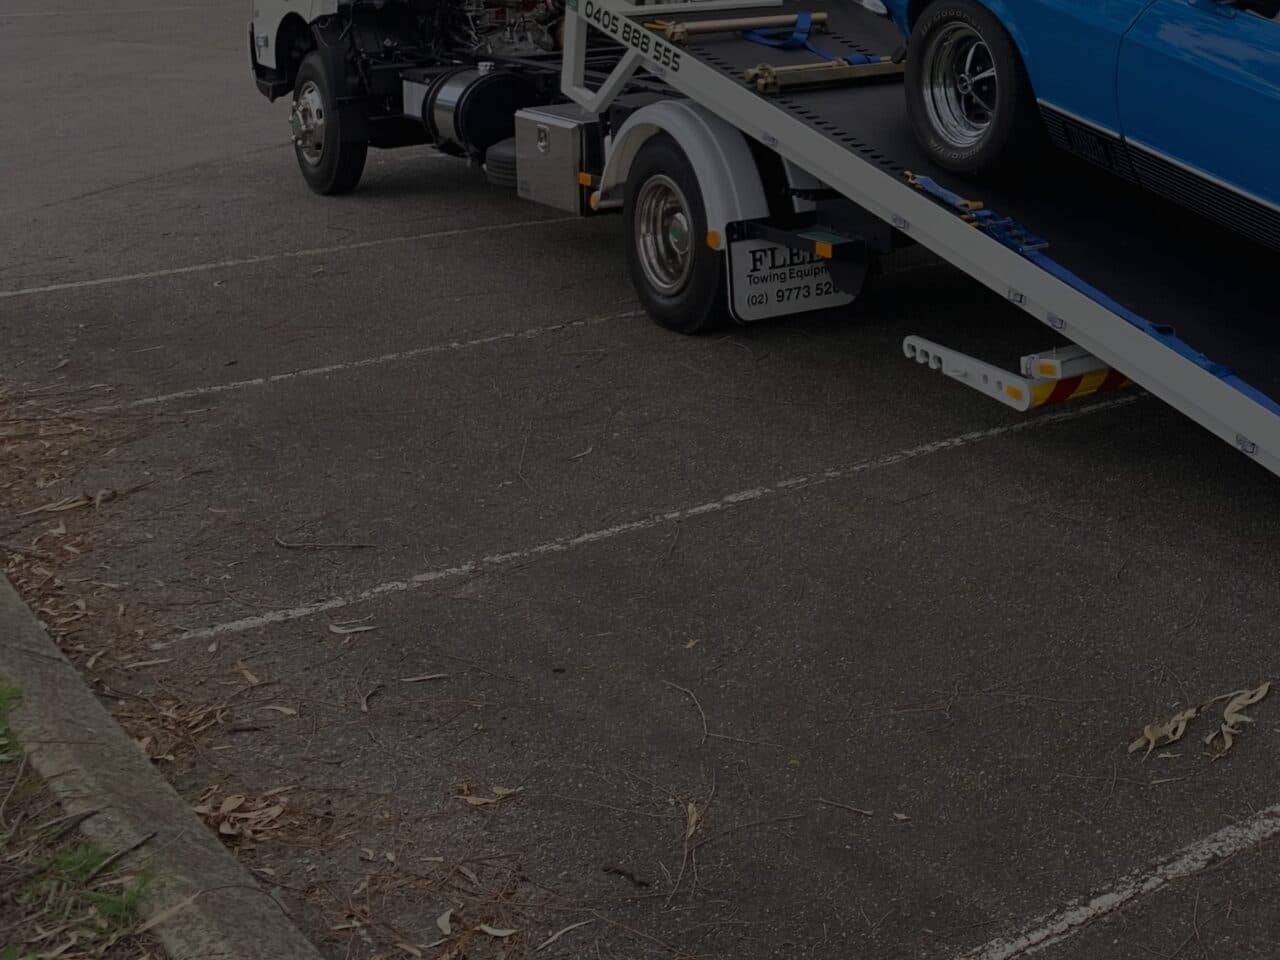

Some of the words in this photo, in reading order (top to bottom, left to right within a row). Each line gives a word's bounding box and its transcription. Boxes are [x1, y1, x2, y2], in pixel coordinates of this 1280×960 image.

[585, 0, 620, 34] 0405
[622, 22, 651, 54] 888
[653, 42, 681, 72] 555
[747, 269, 787, 286] Towing
[747, 292, 769, 306] (02)
[775, 285, 811, 303] 9773
